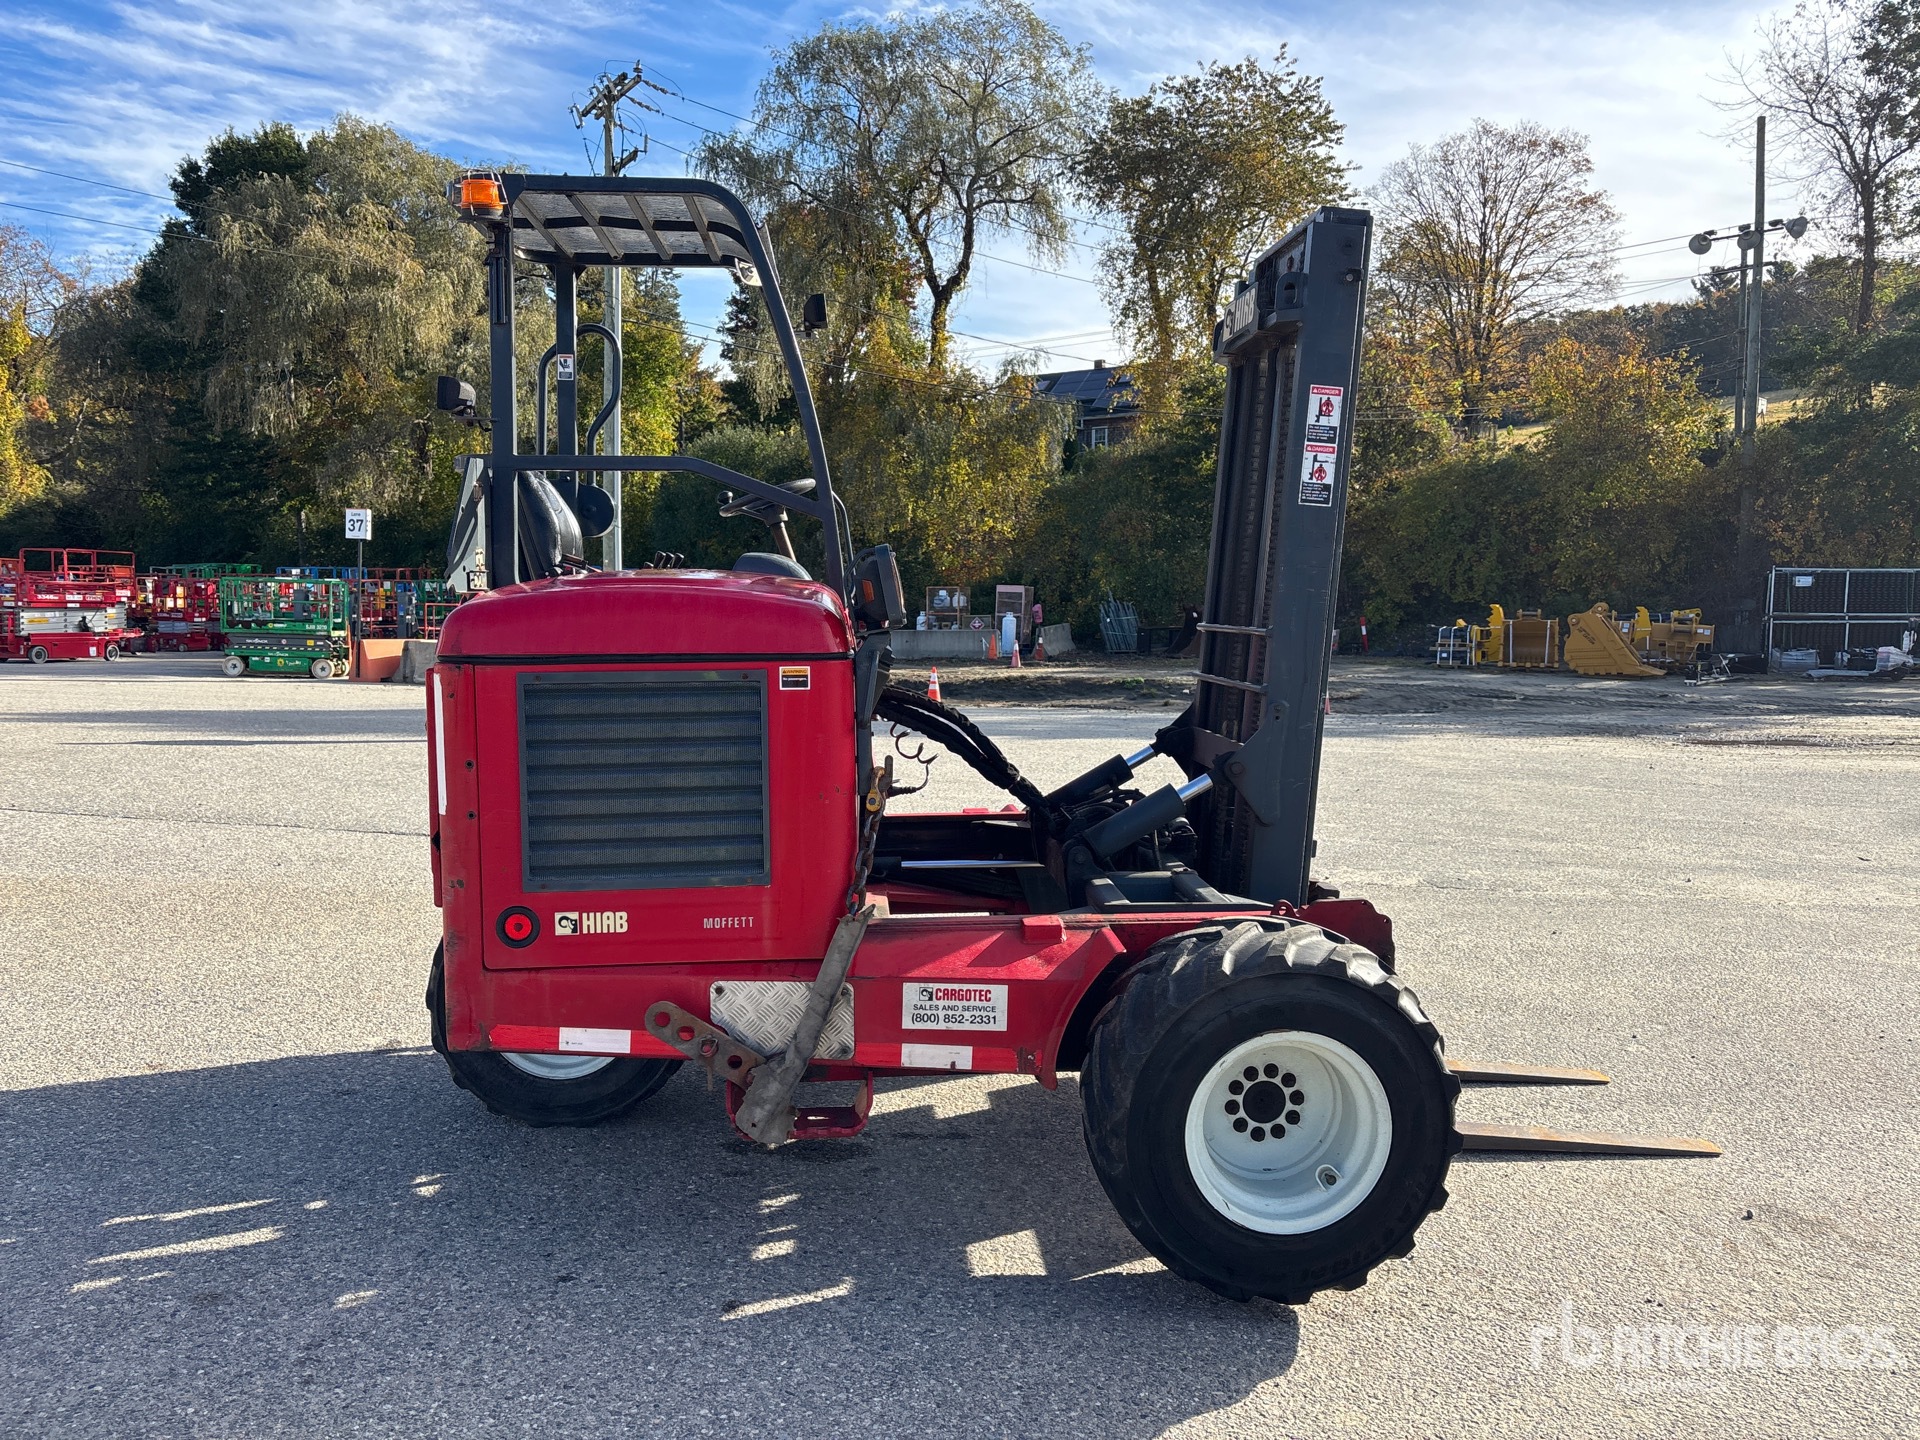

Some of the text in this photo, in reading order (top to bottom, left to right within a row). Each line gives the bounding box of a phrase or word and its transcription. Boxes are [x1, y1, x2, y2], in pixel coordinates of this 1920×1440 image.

[1234, 288, 1255, 333] HIAB
[348, 518, 364, 532] 37
[582, 911, 628, 934] HIAB
[703, 916, 754, 929] MOFFETT
[935, 988, 992, 1002] CARGOTEC
[913, 1004, 939, 1012] SALES
[961, 1005, 997, 1013] SERVICE
[911, 1013, 997, 1025] (800) 852-2331
